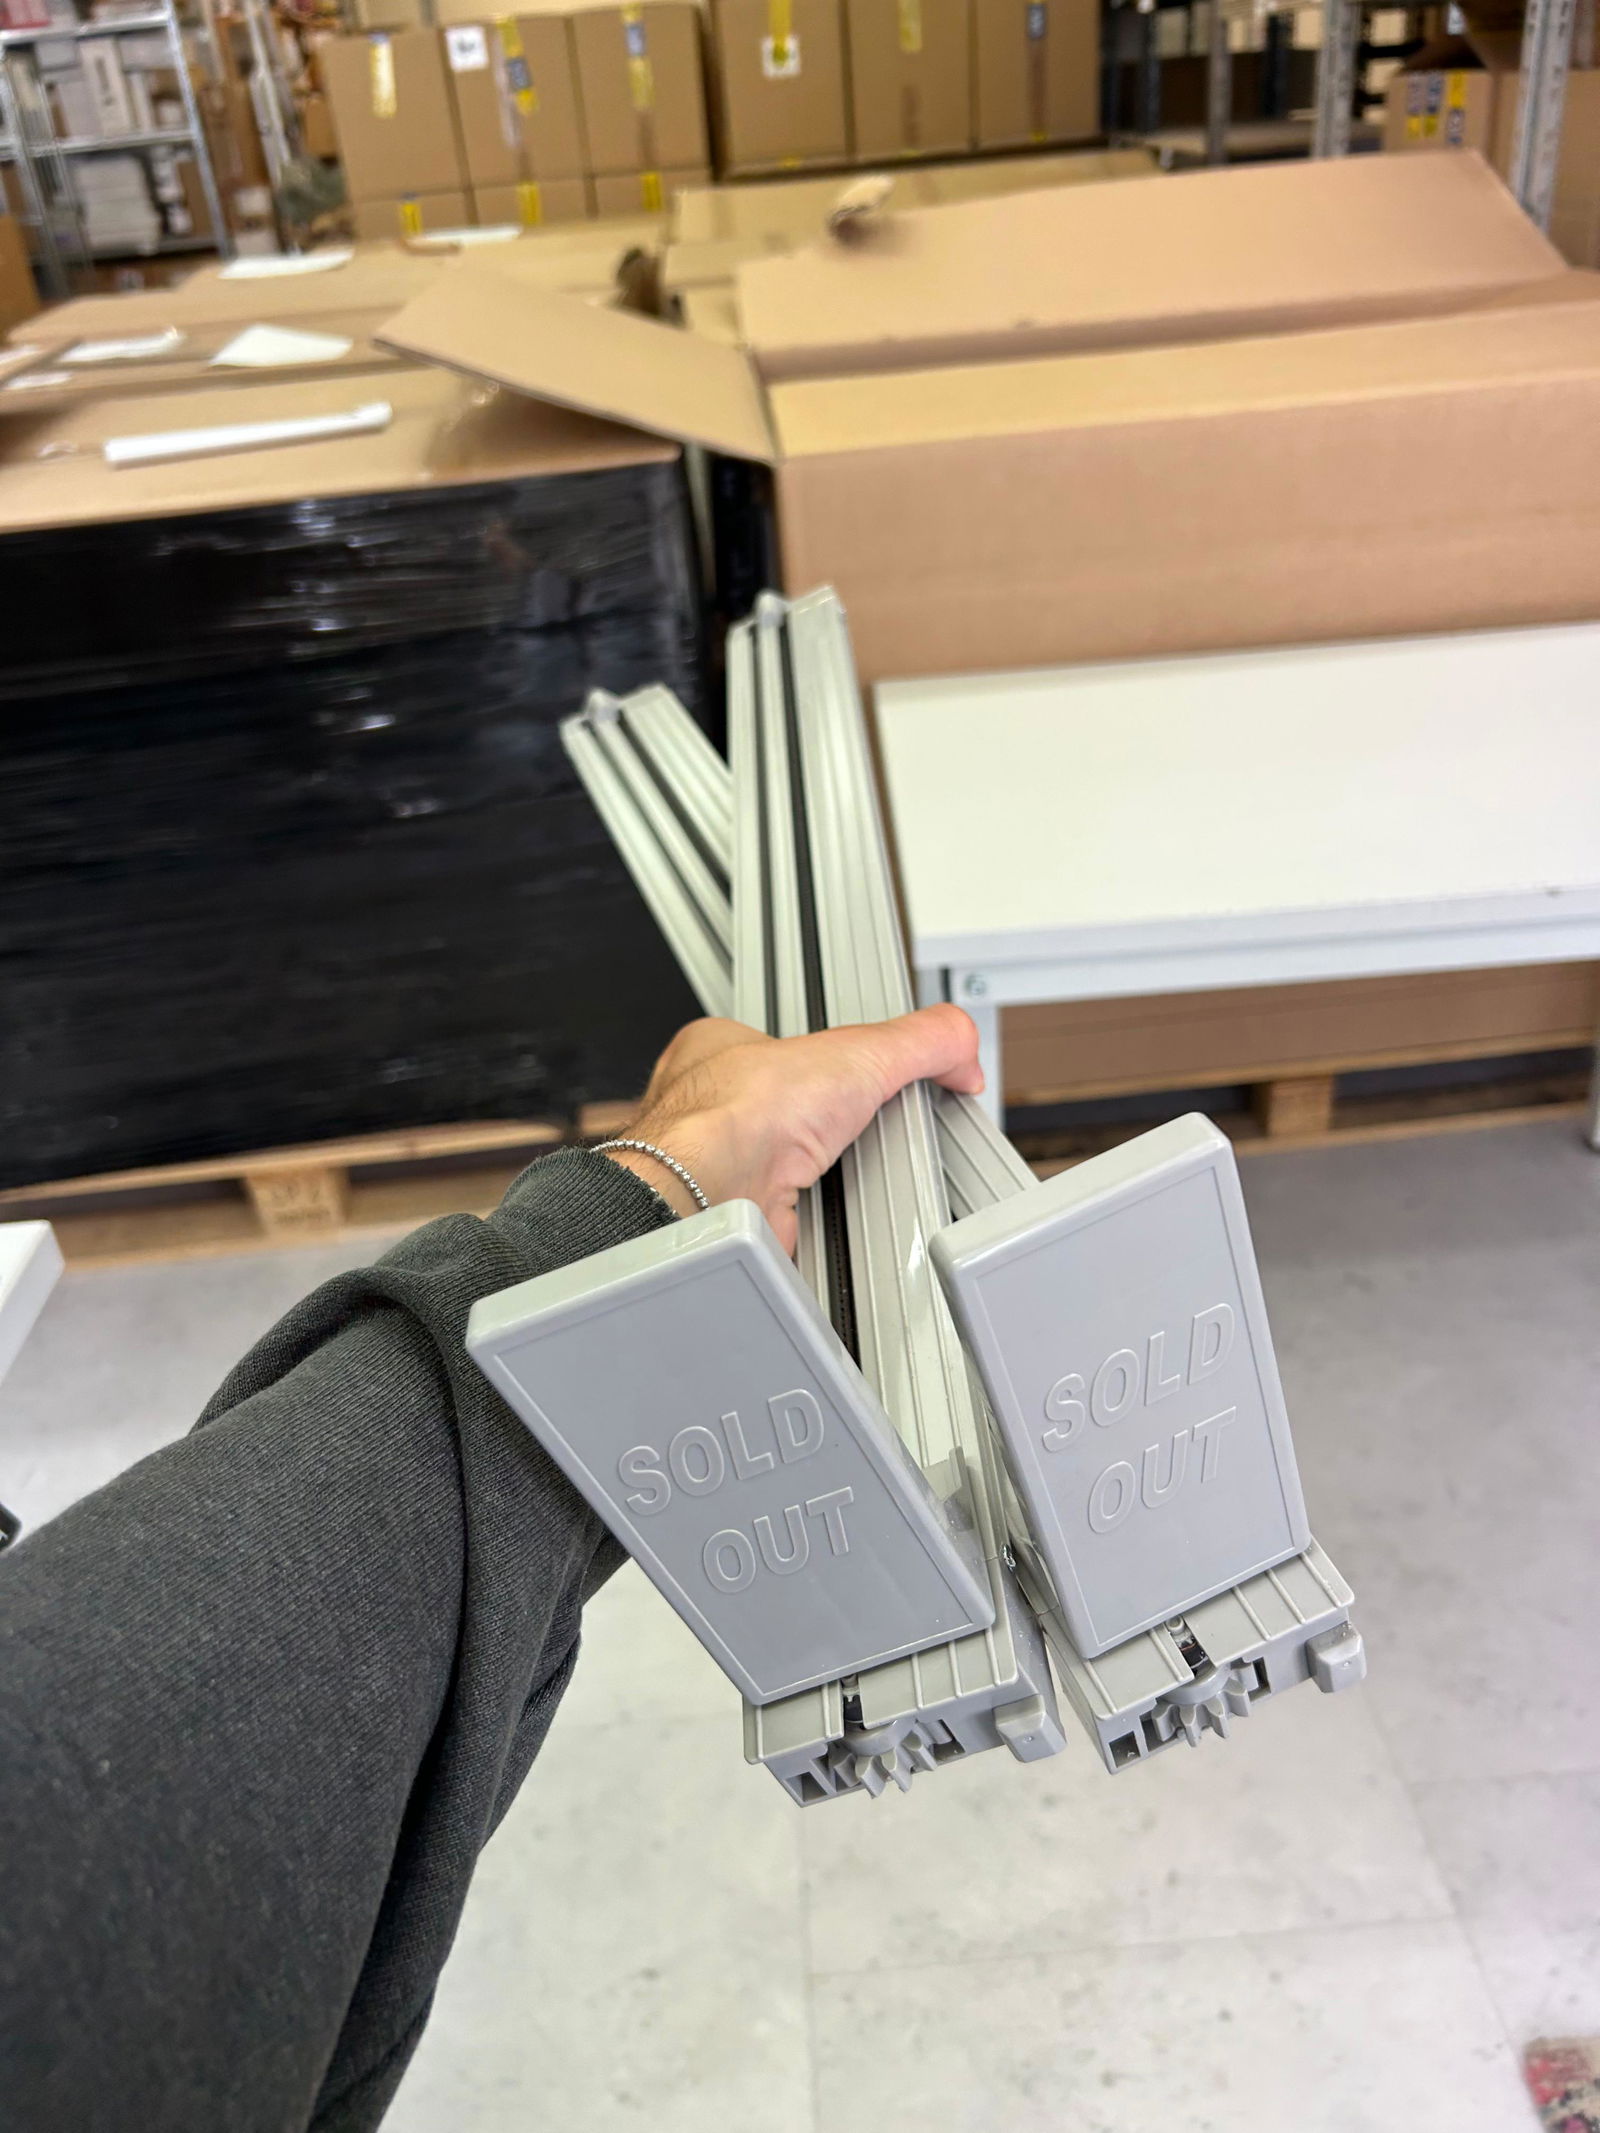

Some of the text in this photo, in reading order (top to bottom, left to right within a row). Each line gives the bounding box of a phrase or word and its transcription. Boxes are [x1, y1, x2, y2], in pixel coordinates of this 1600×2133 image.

[1042, 1302, 1235, 1453] SOLD
[618, 1388, 824, 1516] SOLD
[1087, 1405, 1237, 1534] OUT
[703, 1486, 854, 1593] OUT
